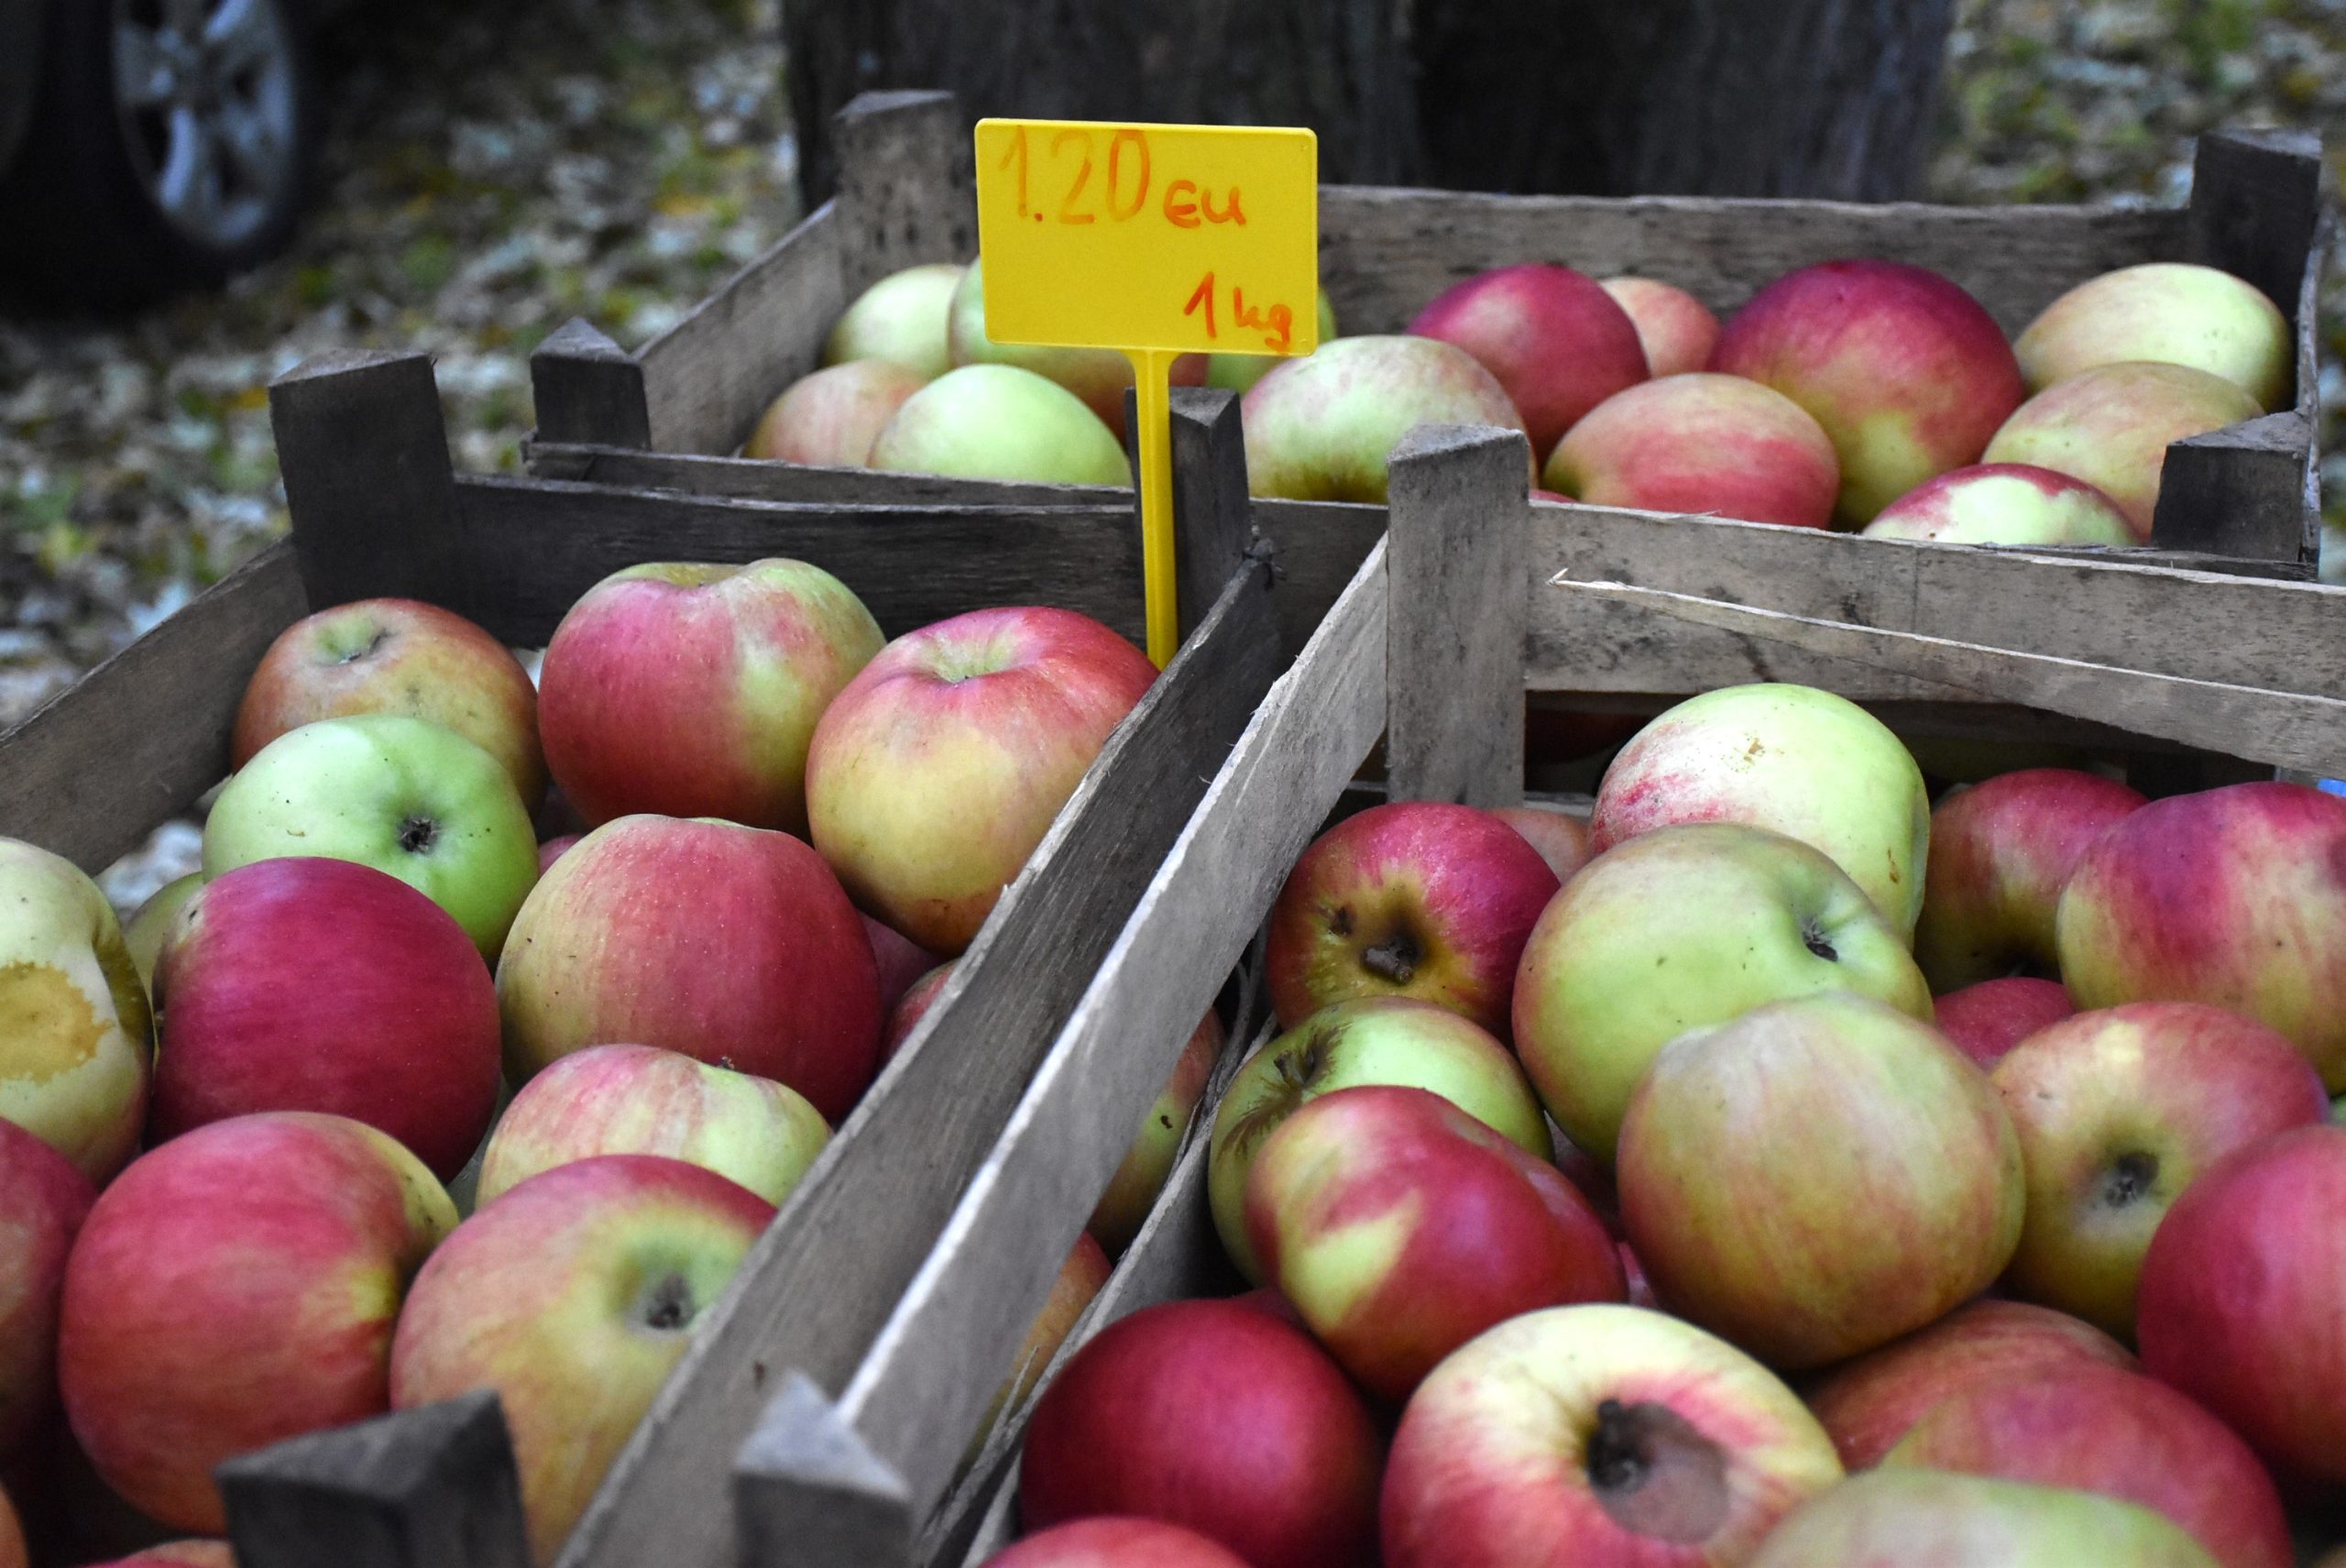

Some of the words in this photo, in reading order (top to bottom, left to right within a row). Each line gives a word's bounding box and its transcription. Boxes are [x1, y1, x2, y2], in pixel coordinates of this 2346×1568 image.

[999, 126, 1152, 225] 1.20
[1182, 271, 1218, 339] 1
[1233, 285, 1293, 356] kg
